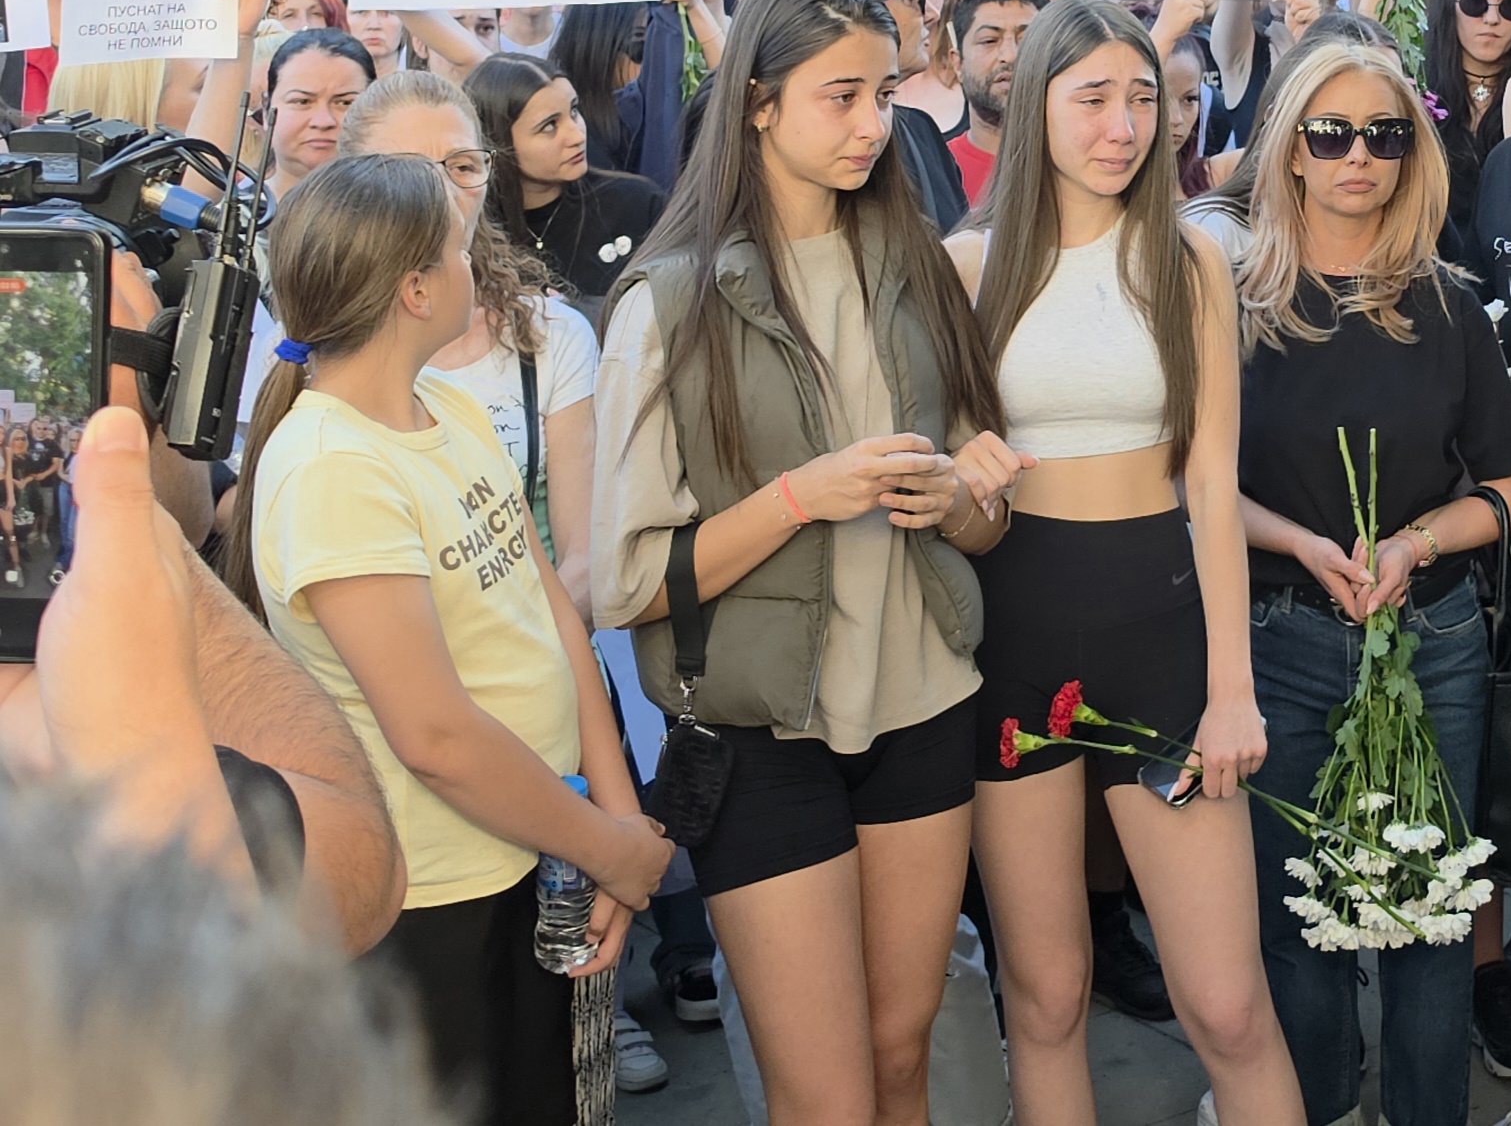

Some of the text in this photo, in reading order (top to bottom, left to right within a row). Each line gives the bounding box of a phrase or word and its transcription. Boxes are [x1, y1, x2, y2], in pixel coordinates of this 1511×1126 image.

[108, 4, 186, 17] ПУСНАТ НА
[78, 19, 217, 36] СВОБОДА, ЗАЩОТО
[108, 36, 183, 50] НЕ ПОМНИ
